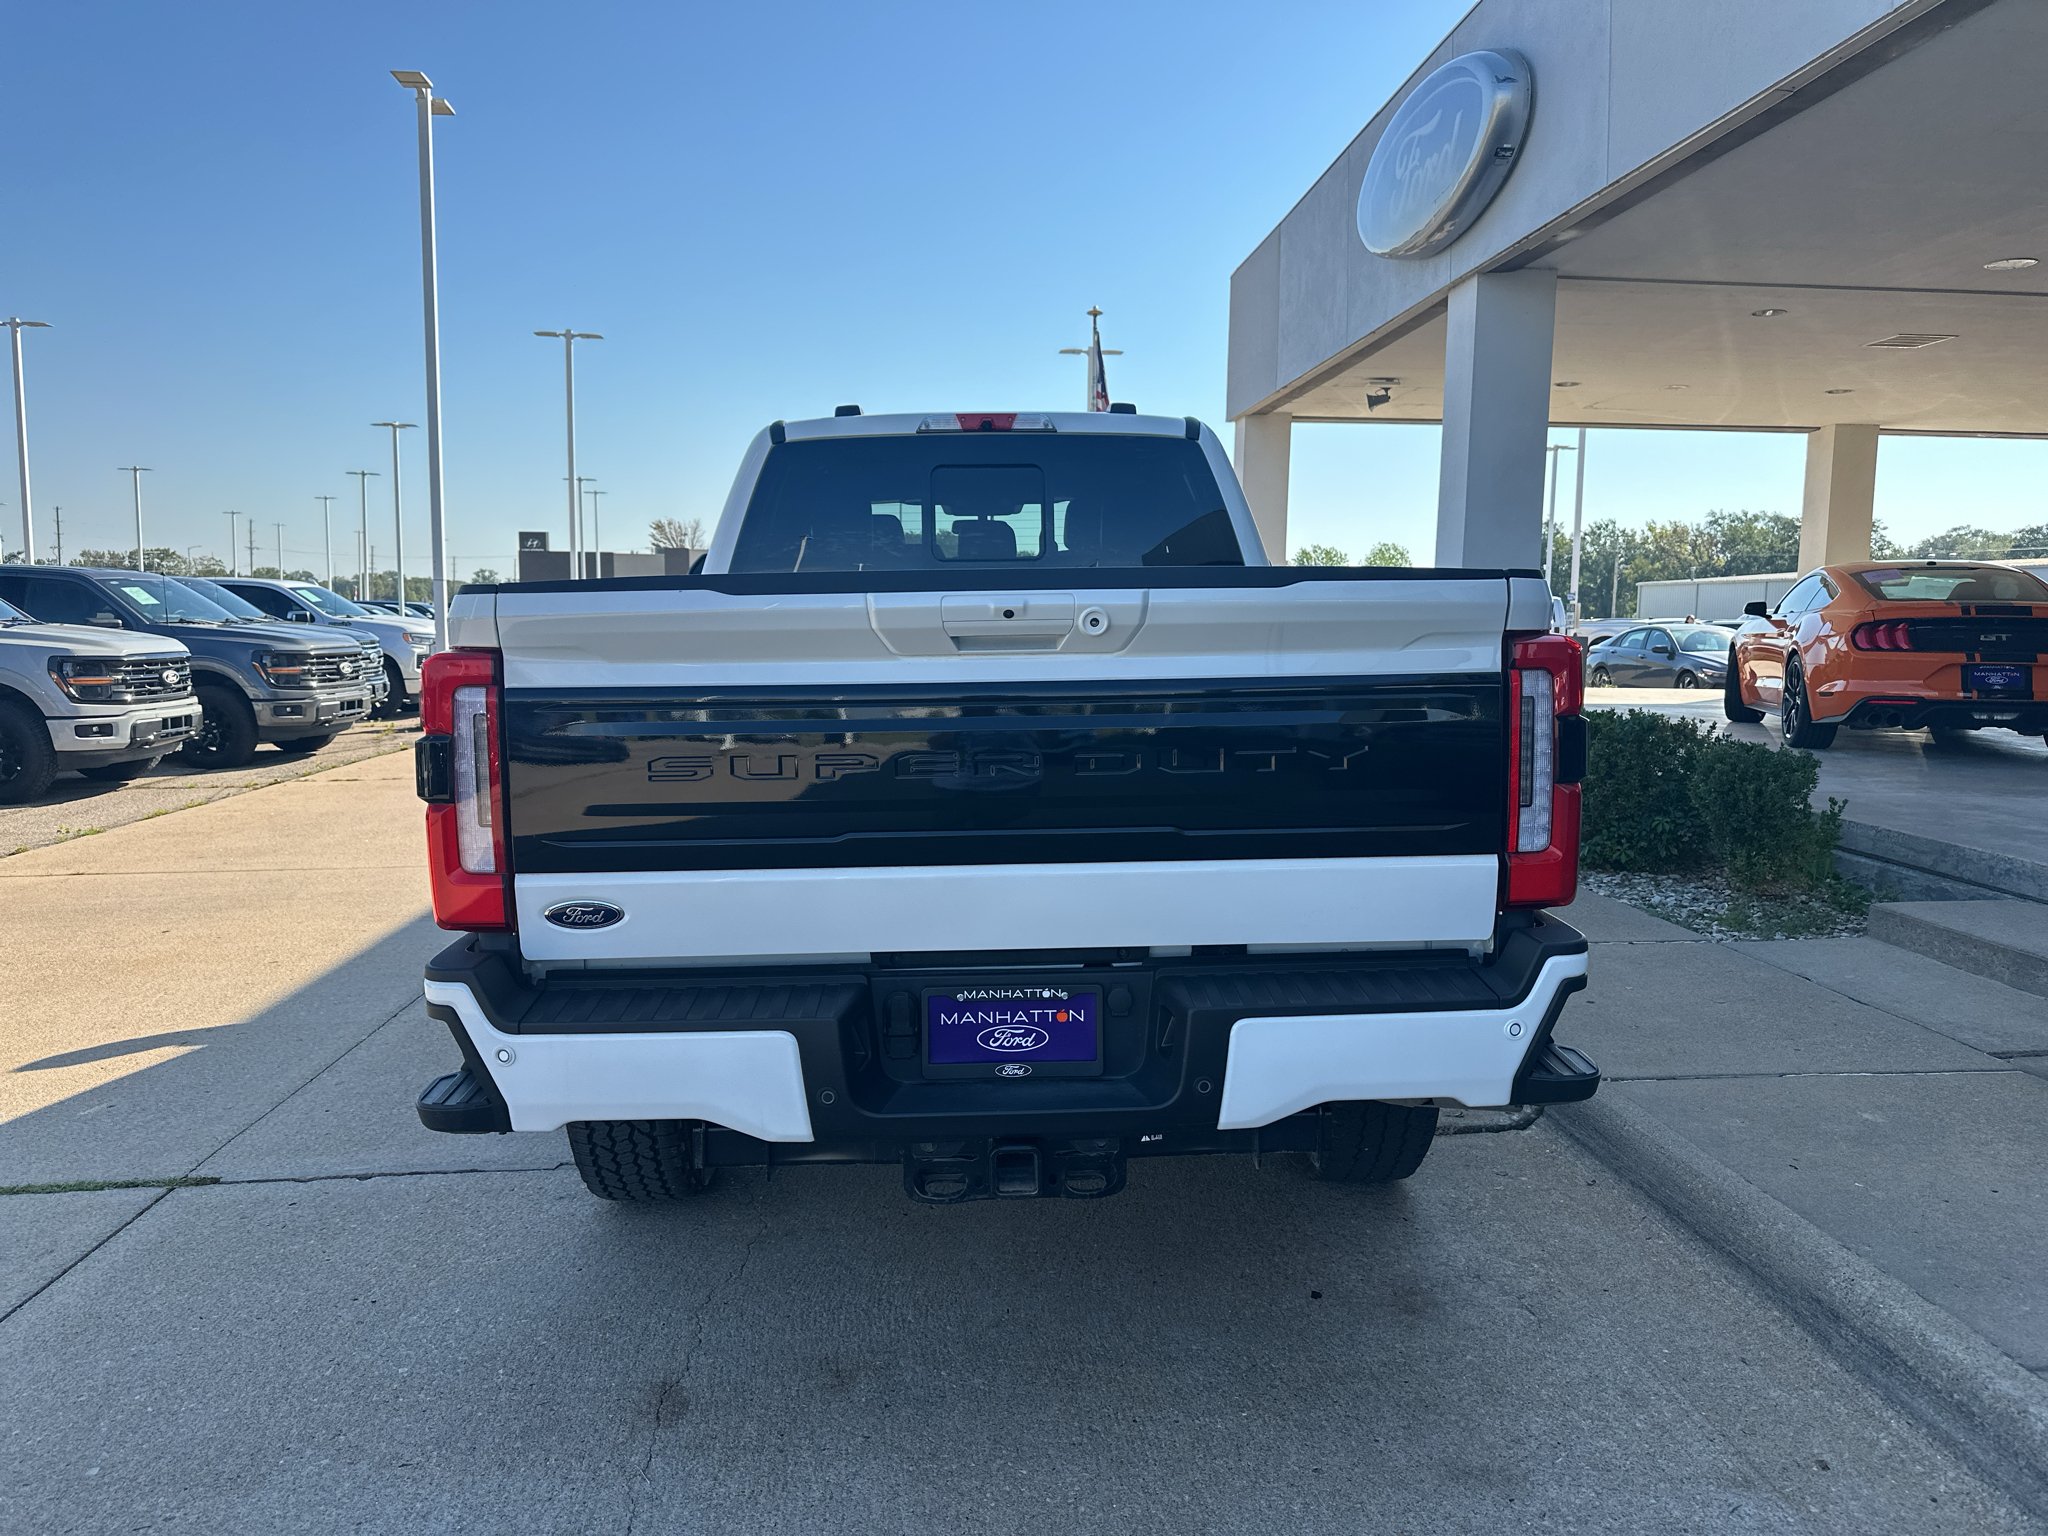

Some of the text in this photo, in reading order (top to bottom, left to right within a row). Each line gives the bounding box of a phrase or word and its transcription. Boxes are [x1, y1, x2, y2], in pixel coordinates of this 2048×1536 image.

[1390, 108, 1463, 223] Ford
[647, 745, 1369, 782] SUPER DUTY
[562, 906, 605, 923] Ford
[989, 1028, 1037, 1047] Ford
[1002, 1065, 1025, 1075] Ford
